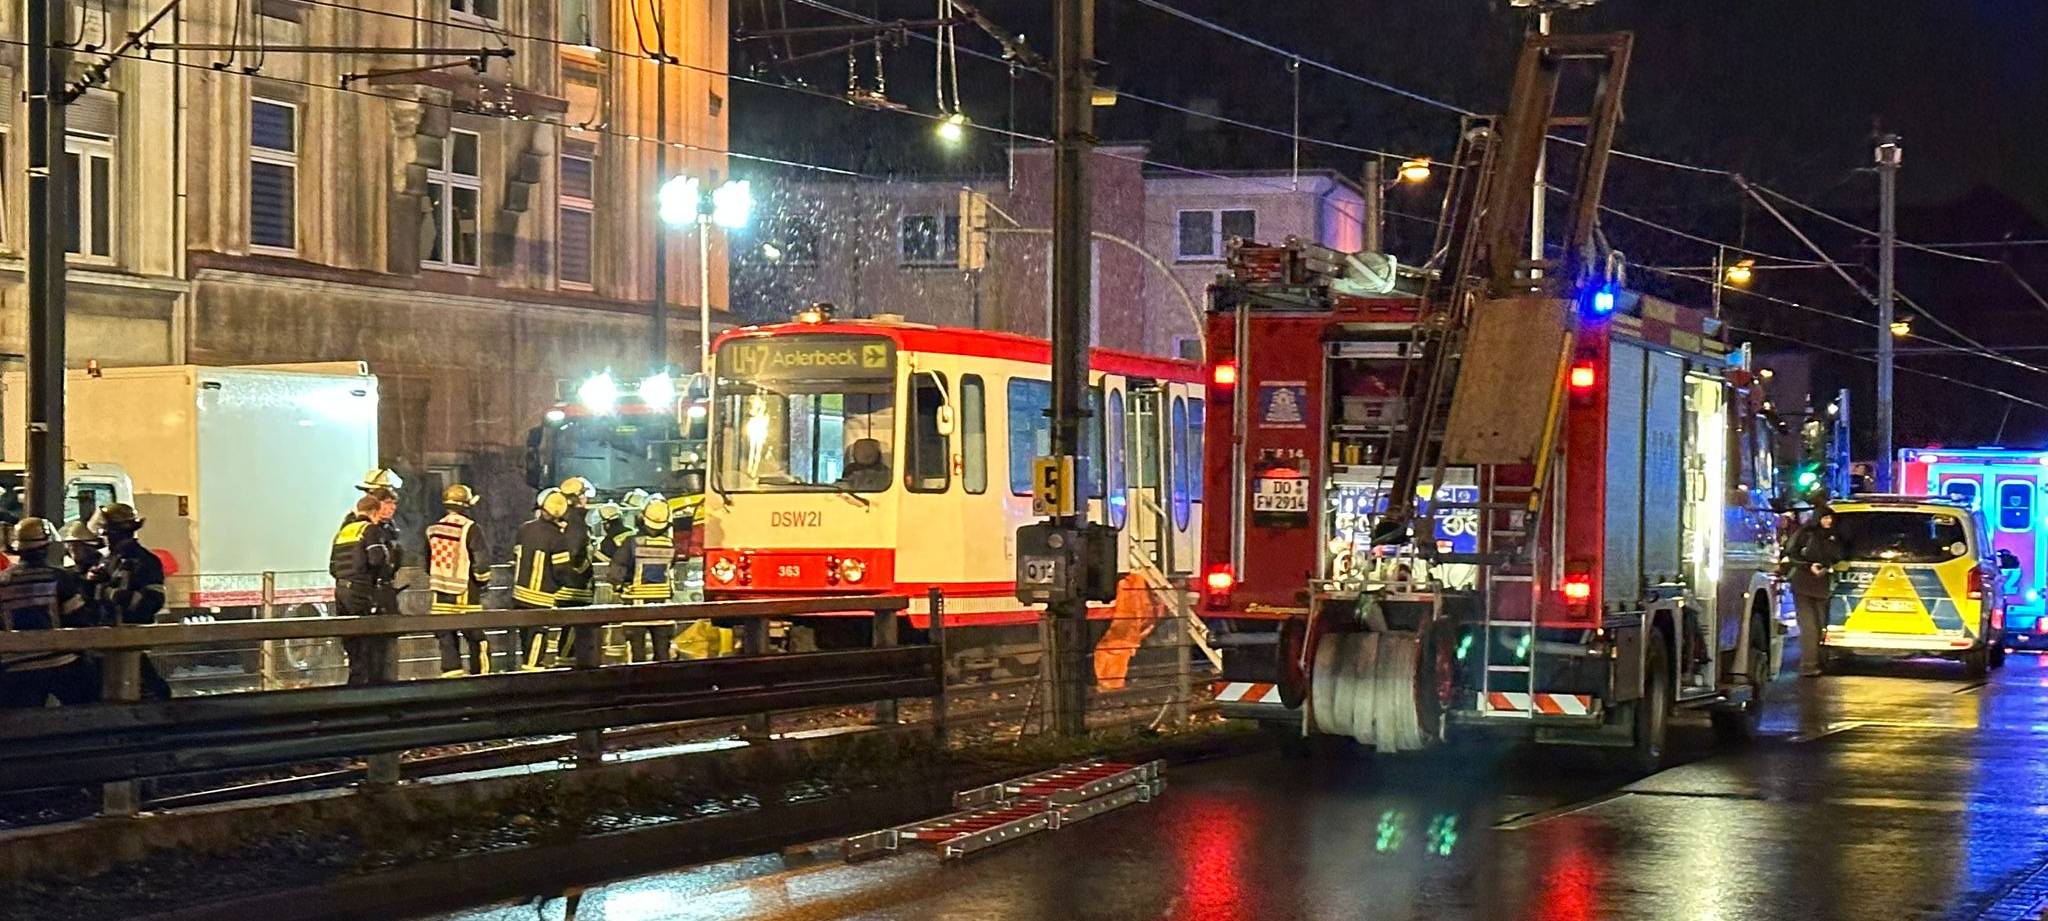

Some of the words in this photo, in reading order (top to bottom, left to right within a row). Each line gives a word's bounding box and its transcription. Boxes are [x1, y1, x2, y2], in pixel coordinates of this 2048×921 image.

[733, 345, 769, 374] U47
[773, 349, 857, 367] Aplerbeck
[1045, 466, 1062, 504] 5
[1273, 481, 1291, 494] DO
[1257, 495, 1273, 508] FW
[1275, 495, 1305, 509] 2914
[778, 565, 800, 577] 363
